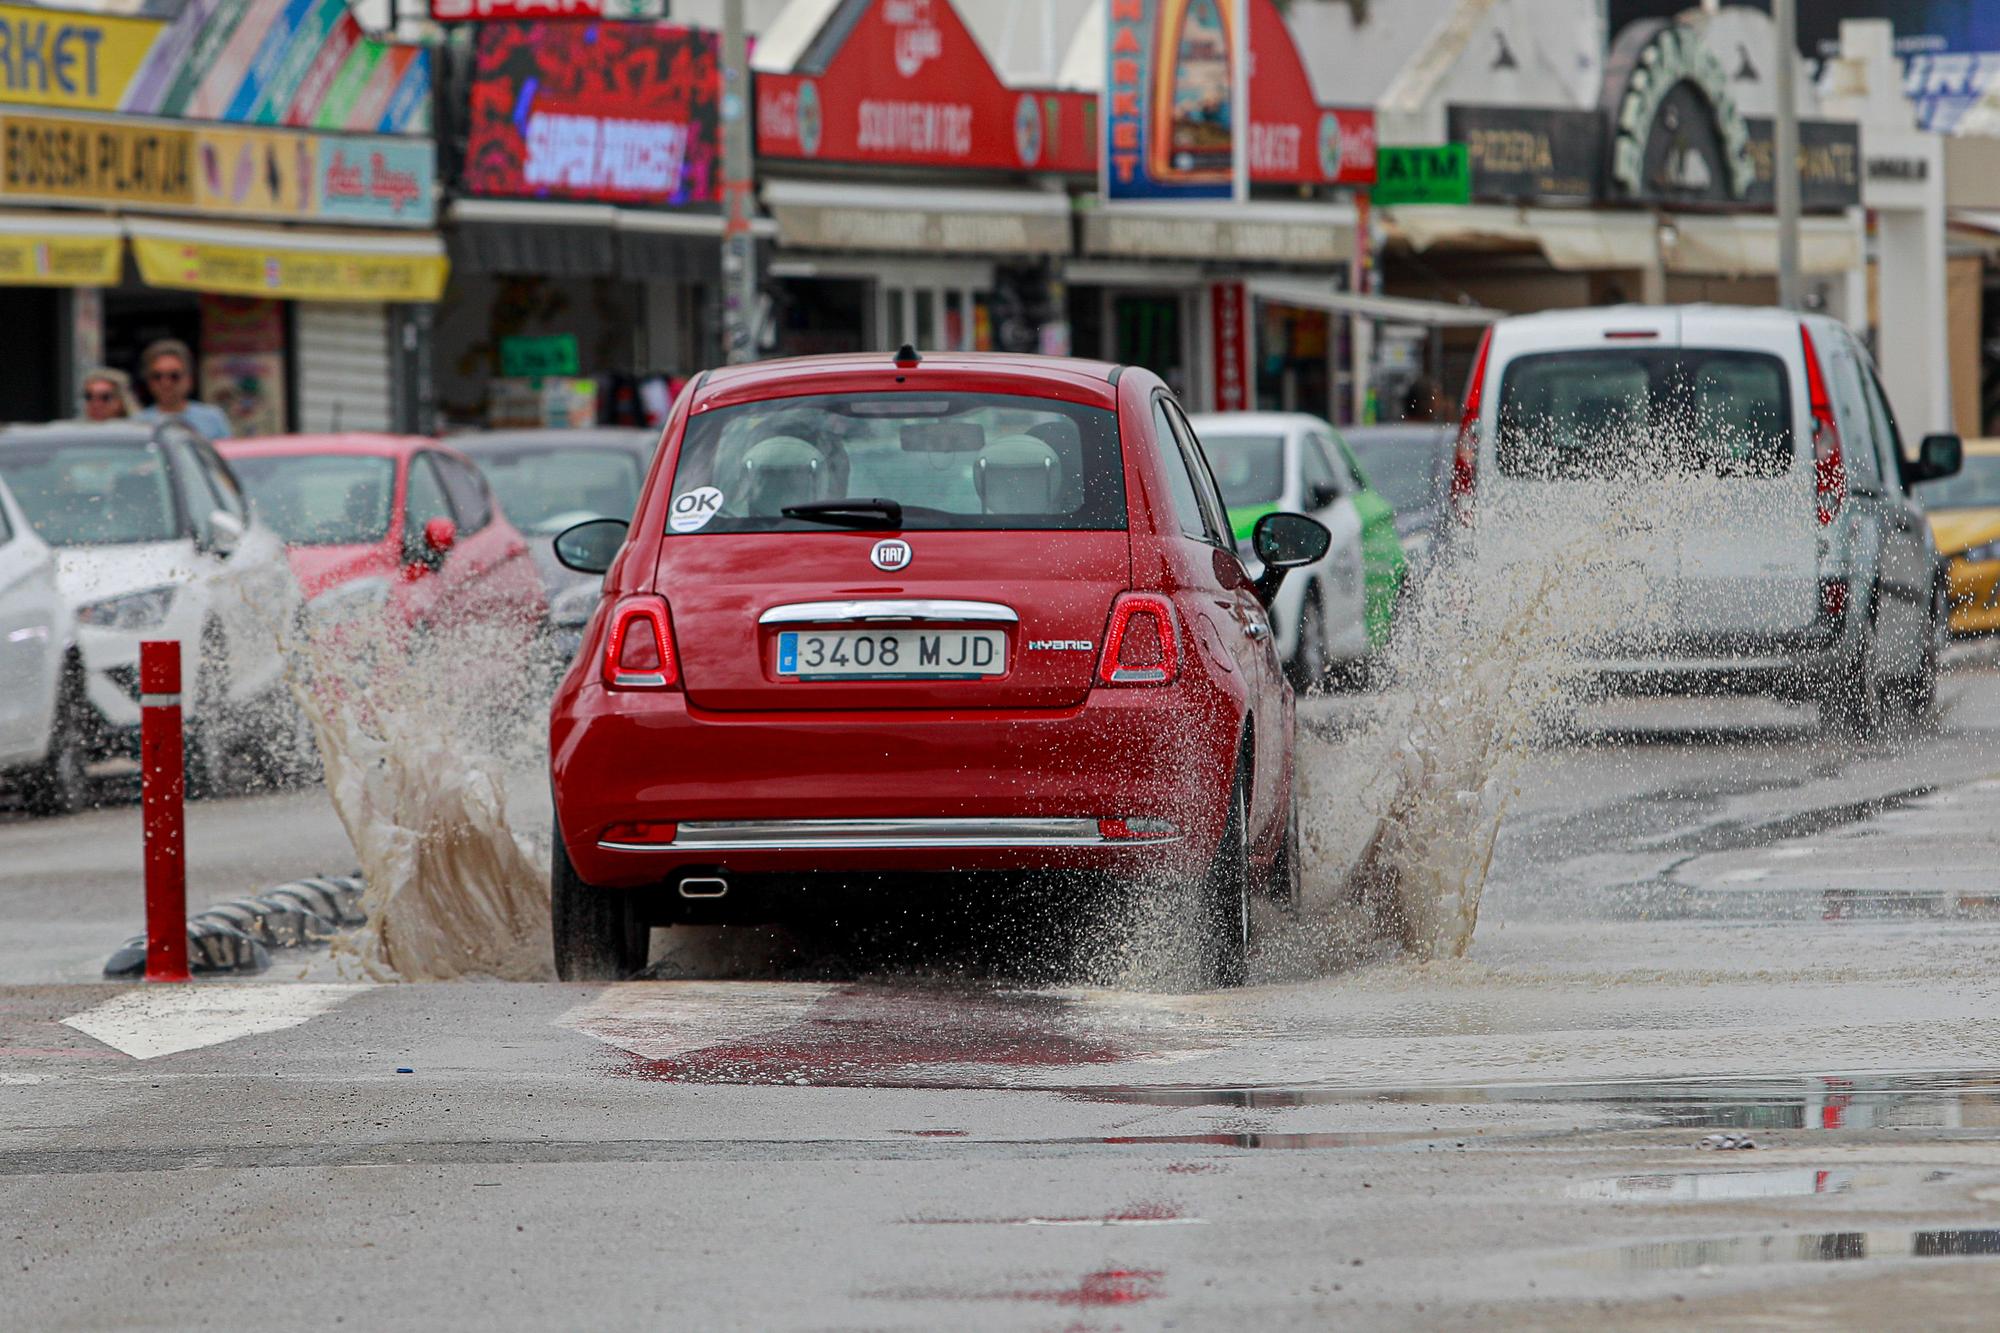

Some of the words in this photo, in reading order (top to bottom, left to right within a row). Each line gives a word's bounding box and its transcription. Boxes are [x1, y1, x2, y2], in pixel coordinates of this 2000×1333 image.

[857, 99, 973, 156] SOUVENIRS
[6, 124, 90, 188] BOSSA
[525, 112, 598, 187] SUPER
[1386, 153, 1459, 180] ATM
[675, 493, 719, 513] OK
[880, 547, 904, 562] FIAT
[805, 637, 899, 667] 3408
[919, 636, 993, 667] MJD
[1028, 640, 1093, 650] HYBRID
